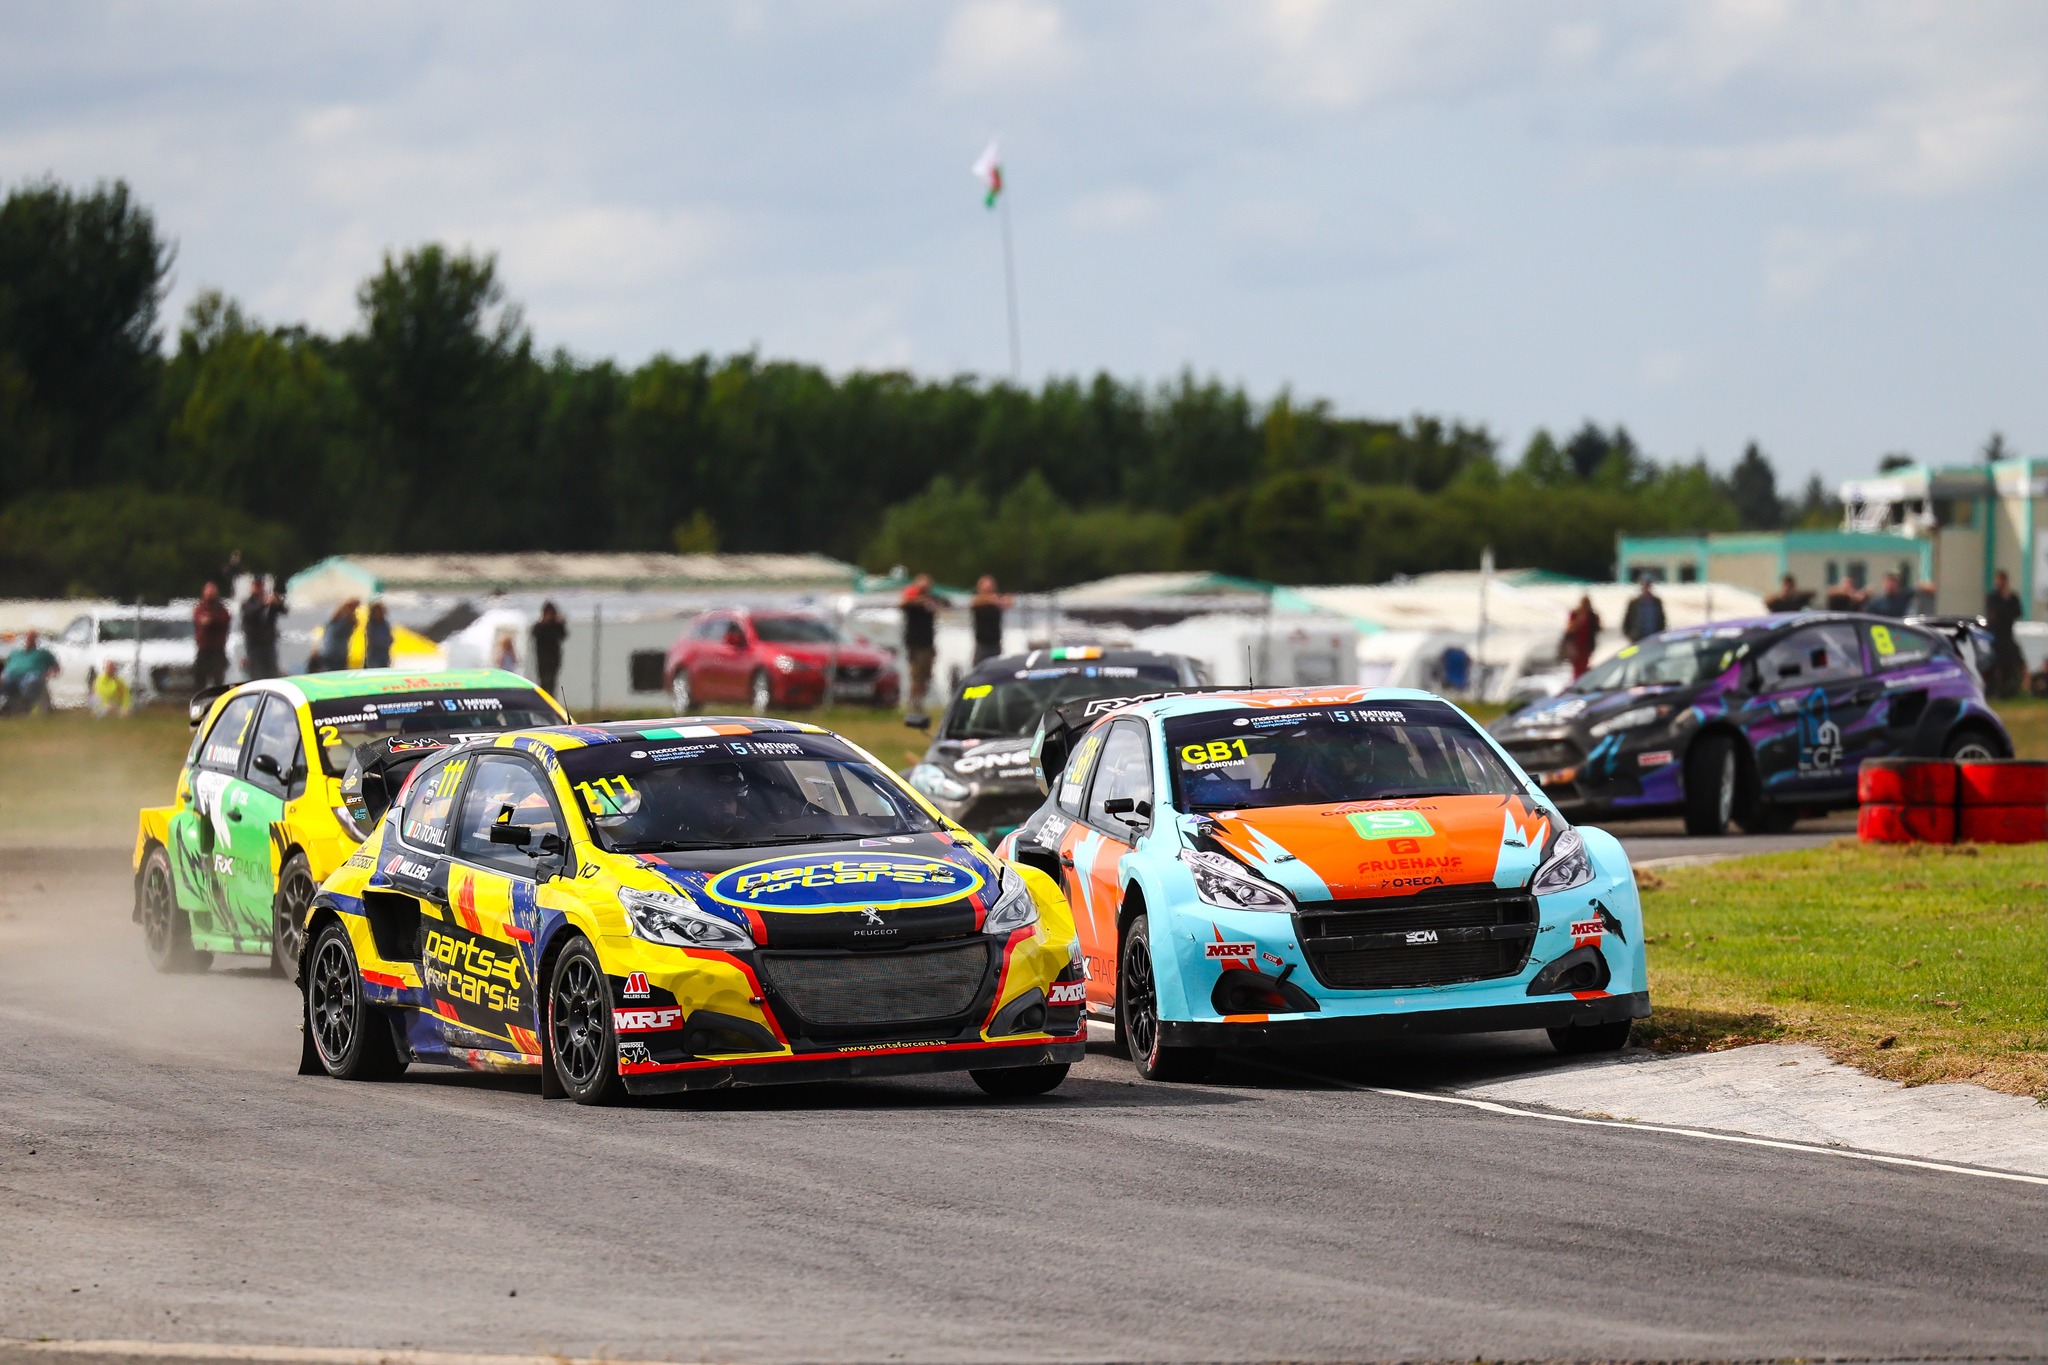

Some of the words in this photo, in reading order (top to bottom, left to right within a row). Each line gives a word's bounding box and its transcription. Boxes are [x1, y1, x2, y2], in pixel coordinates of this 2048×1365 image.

[1870, 625, 1896, 655] 8
[444, 699, 457, 711] 5
[314, 712, 379, 727] O'DONOVAN
[1251, 712, 1308, 722] motorsport
[1333, 711, 1350, 722] 5
[1358, 710, 1404, 718] NATIONS
[319, 726, 343, 748] 2
[648, 744, 705, 755] motorsport
[730, 742, 748, 755] 5
[754, 742, 800, 750] NATIONS
[1181, 738, 1249, 765] GB1
[1196, 759, 1245, 771] O'DONOVAN
[441, 759, 468, 798] 111
[573, 774, 635, 801] 111
[1321, 805, 1438, 817] Commercial
[421, 824, 448, 848] TOHILL
[397, 859, 432, 881] MILLERS
[1358, 856, 1463, 874] FRUEHAUF
[735, 860, 893, 893] parts
[1392, 876, 1444, 888] ORECA
[853, 928, 899, 936] PEUGEOT
[1405, 930, 1438, 942] SCM
[424, 930, 495, 978] parts
[1206, 944, 1255, 956] MRF
[1264, 953, 1278, 963] TOW
[1081, 954, 1093, 980] X
[613, 1009, 681, 1030] MRF
[837, 1040, 947, 1053] www.partsforcars.ie
